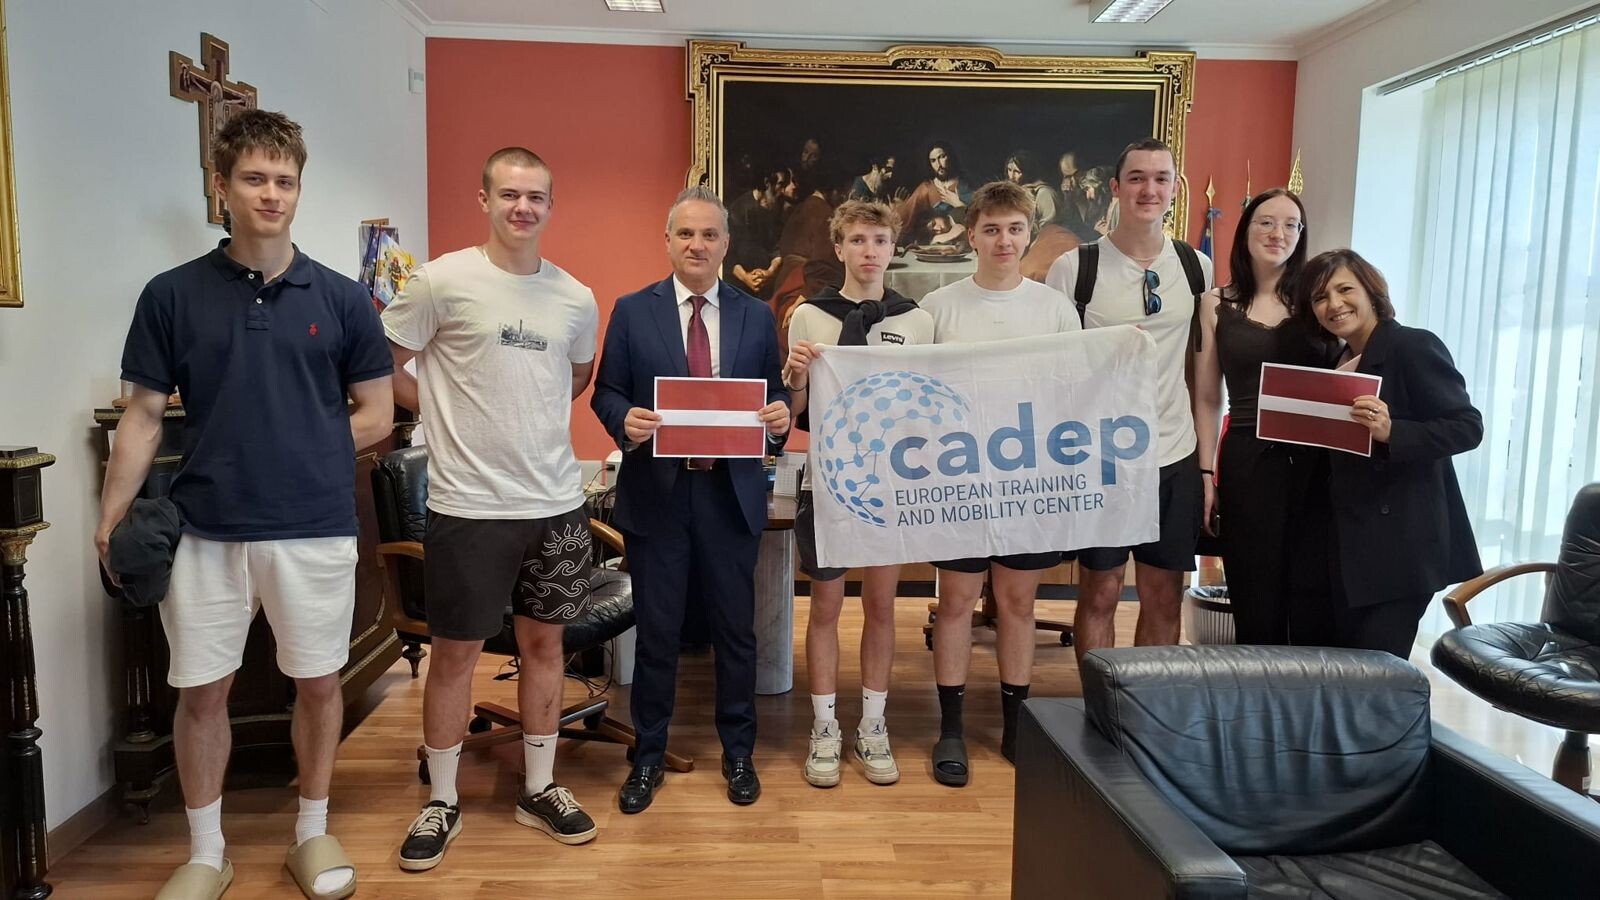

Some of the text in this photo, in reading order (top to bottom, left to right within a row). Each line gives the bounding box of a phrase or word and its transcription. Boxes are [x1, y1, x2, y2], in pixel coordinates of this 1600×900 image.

[889, 401, 1151, 486] cadep
[895, 473, 1087, 506] EUROPEAN TRAINING
[897, 492, 1104, 527] AND MOBILITY CENTER
